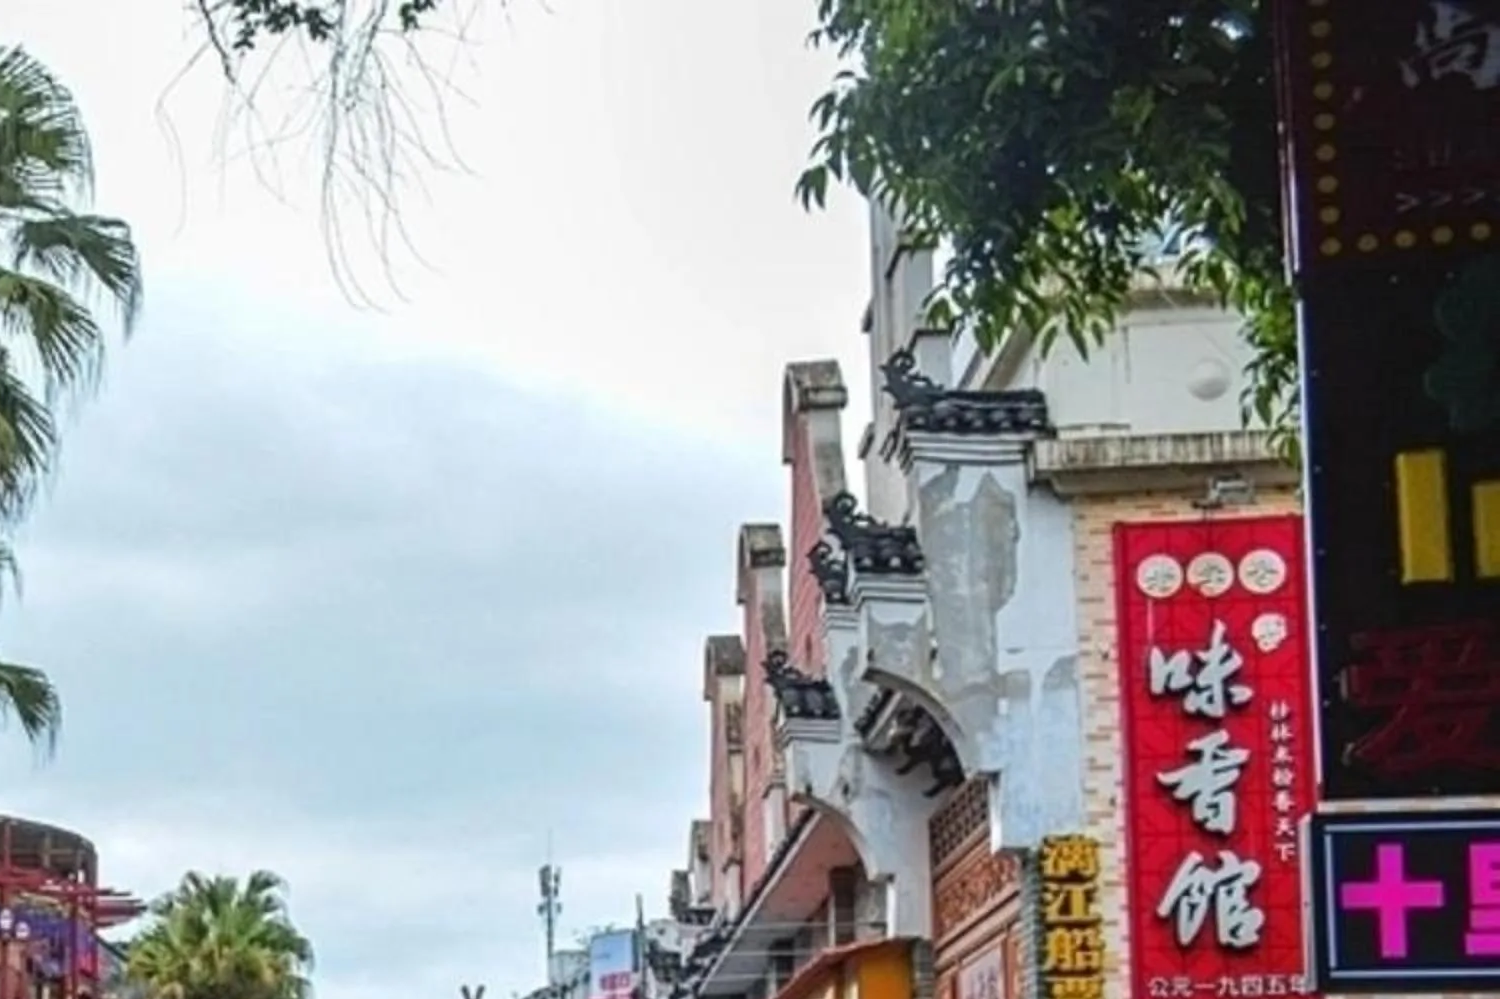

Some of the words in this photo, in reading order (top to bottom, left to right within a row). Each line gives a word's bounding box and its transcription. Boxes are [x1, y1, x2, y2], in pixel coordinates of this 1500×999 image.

[1146, 618, 1268, 953] 味香馆
[1149, 974, 1316, 998] 公元一九四五年
